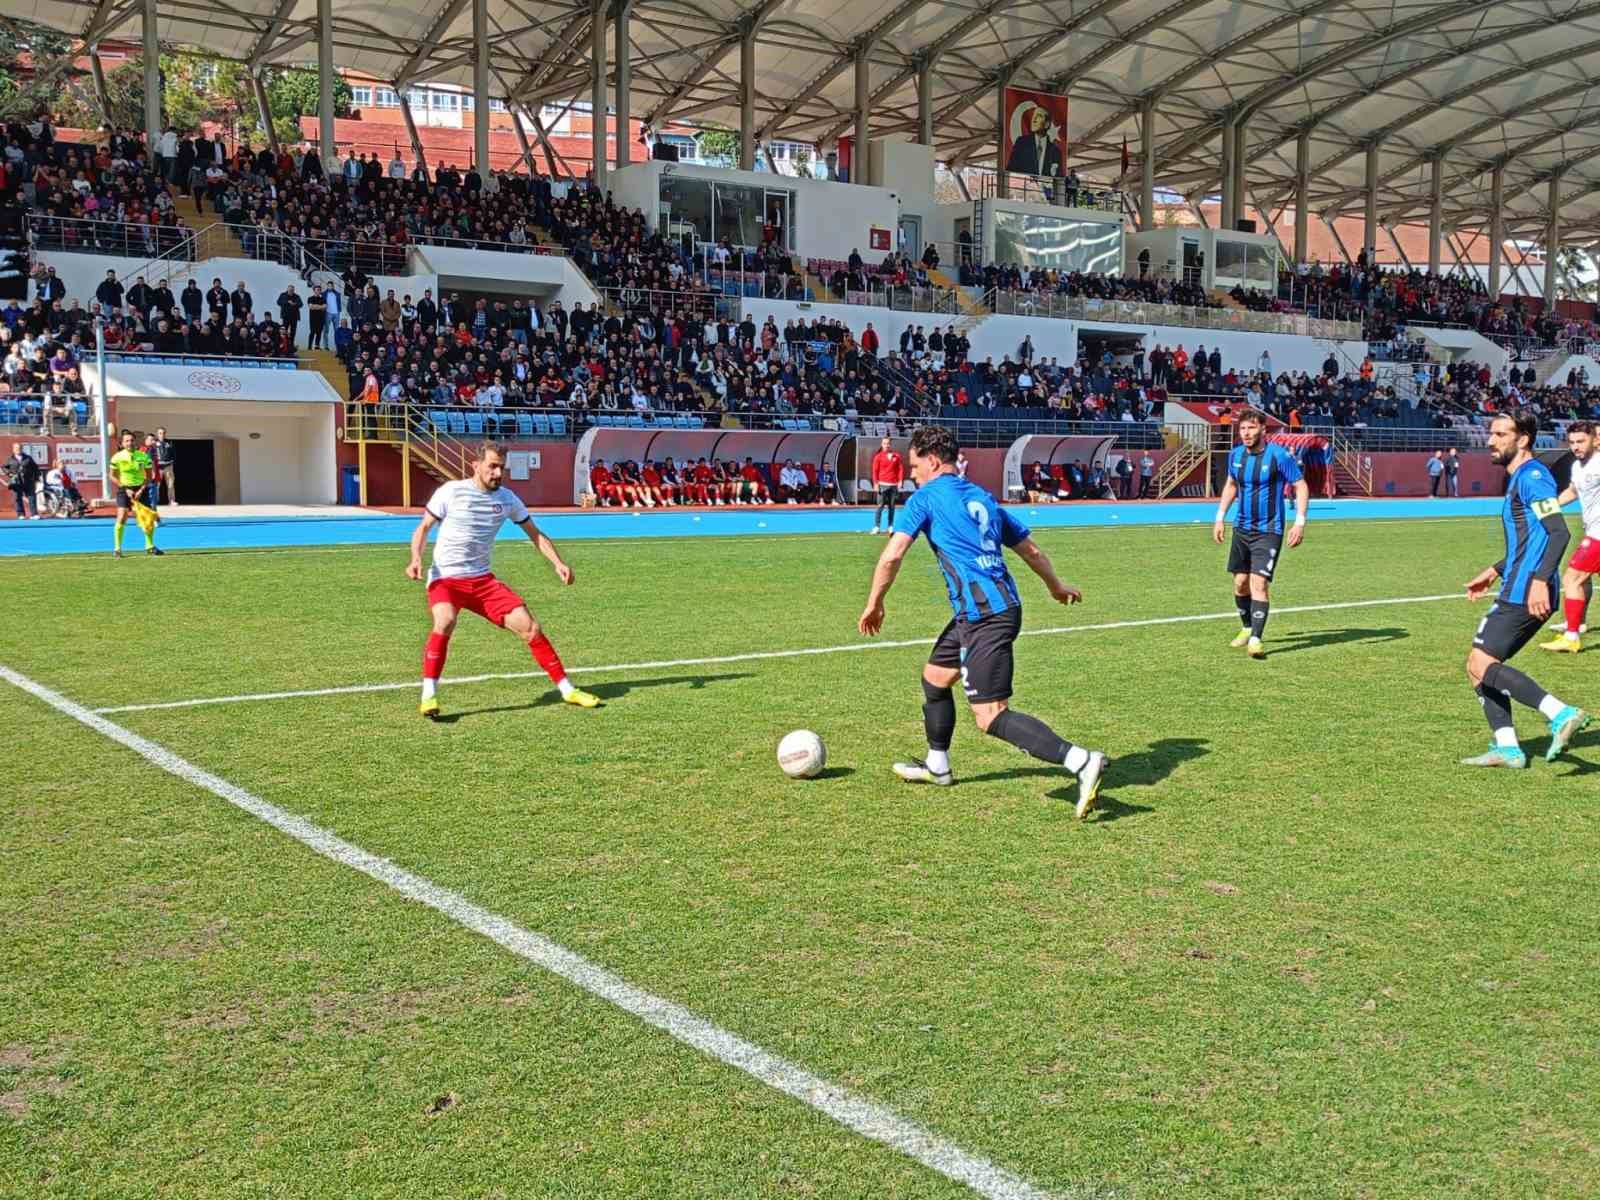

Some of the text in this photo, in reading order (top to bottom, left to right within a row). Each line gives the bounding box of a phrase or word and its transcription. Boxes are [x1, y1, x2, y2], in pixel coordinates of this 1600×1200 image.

[1538, 500, 1553, 514] C
[967, 501, 996, 551] 2
[960, 666, 970, 687] 2
